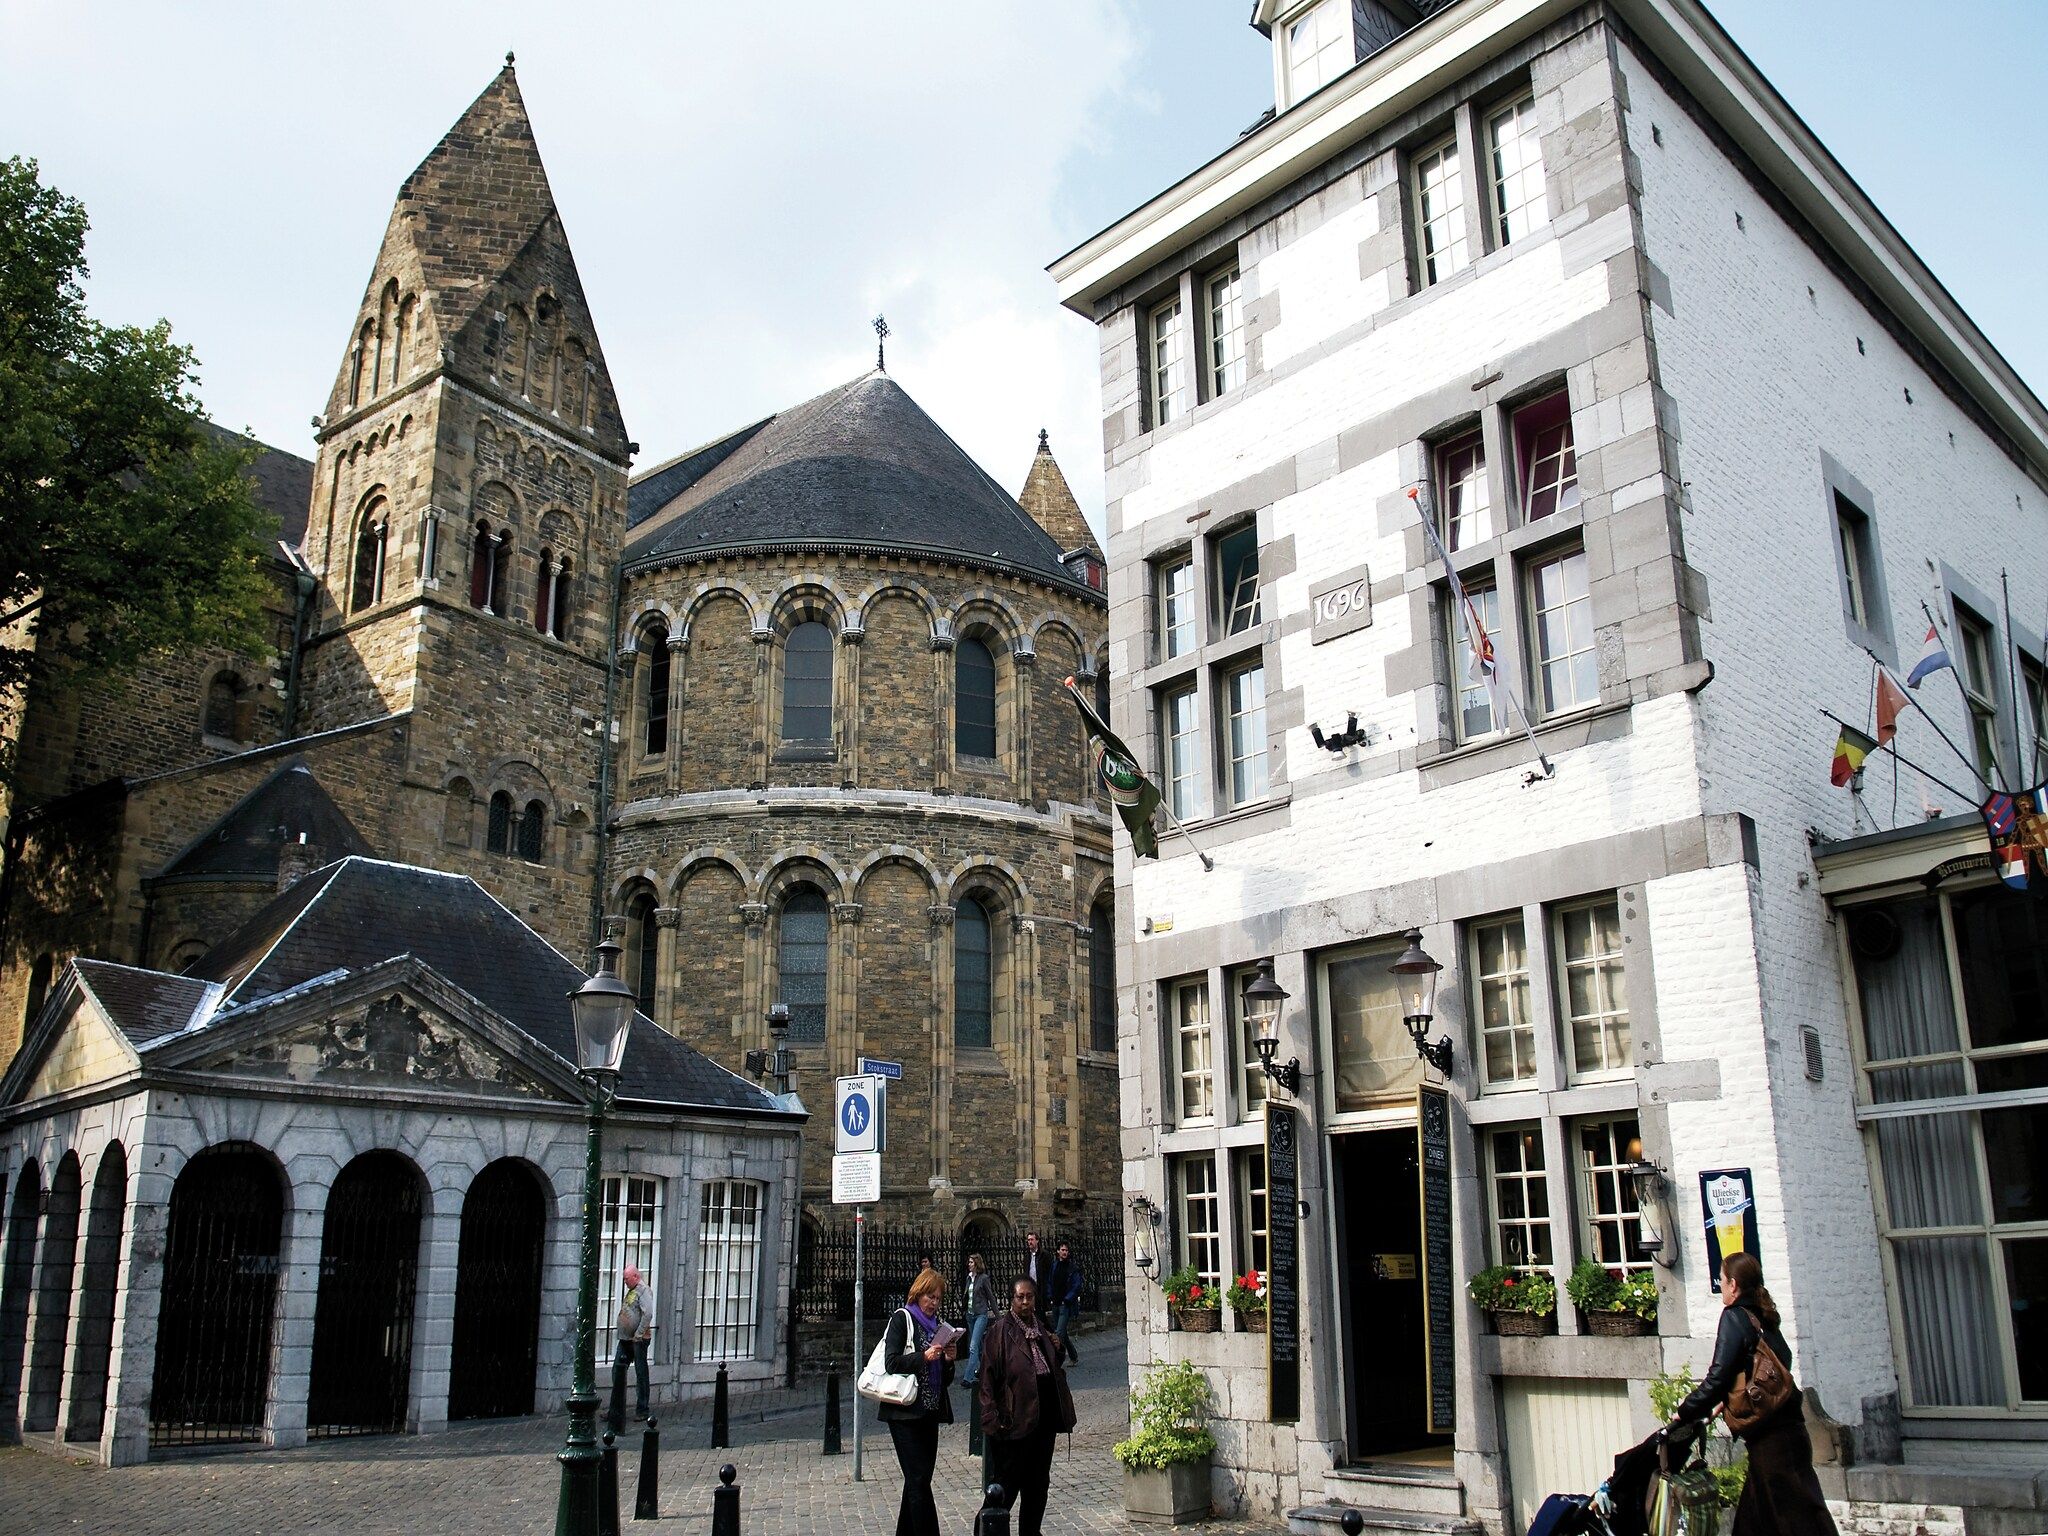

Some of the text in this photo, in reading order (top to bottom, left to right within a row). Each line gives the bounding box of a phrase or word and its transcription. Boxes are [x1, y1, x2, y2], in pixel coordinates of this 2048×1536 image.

[1313, 583, 1365, 626] 1696
[867, 1062, 898, 1075] Stokstraat
[847, 1081, 865, 1091] ZONE
[1428, 1148, 1445, 1161] DINER
[1273, 1160, 1293, 1173] LUNCH
[1711, 1188, 1740, 1198] Wieckse
[1717, 1197, 1736, 1206] Witte
